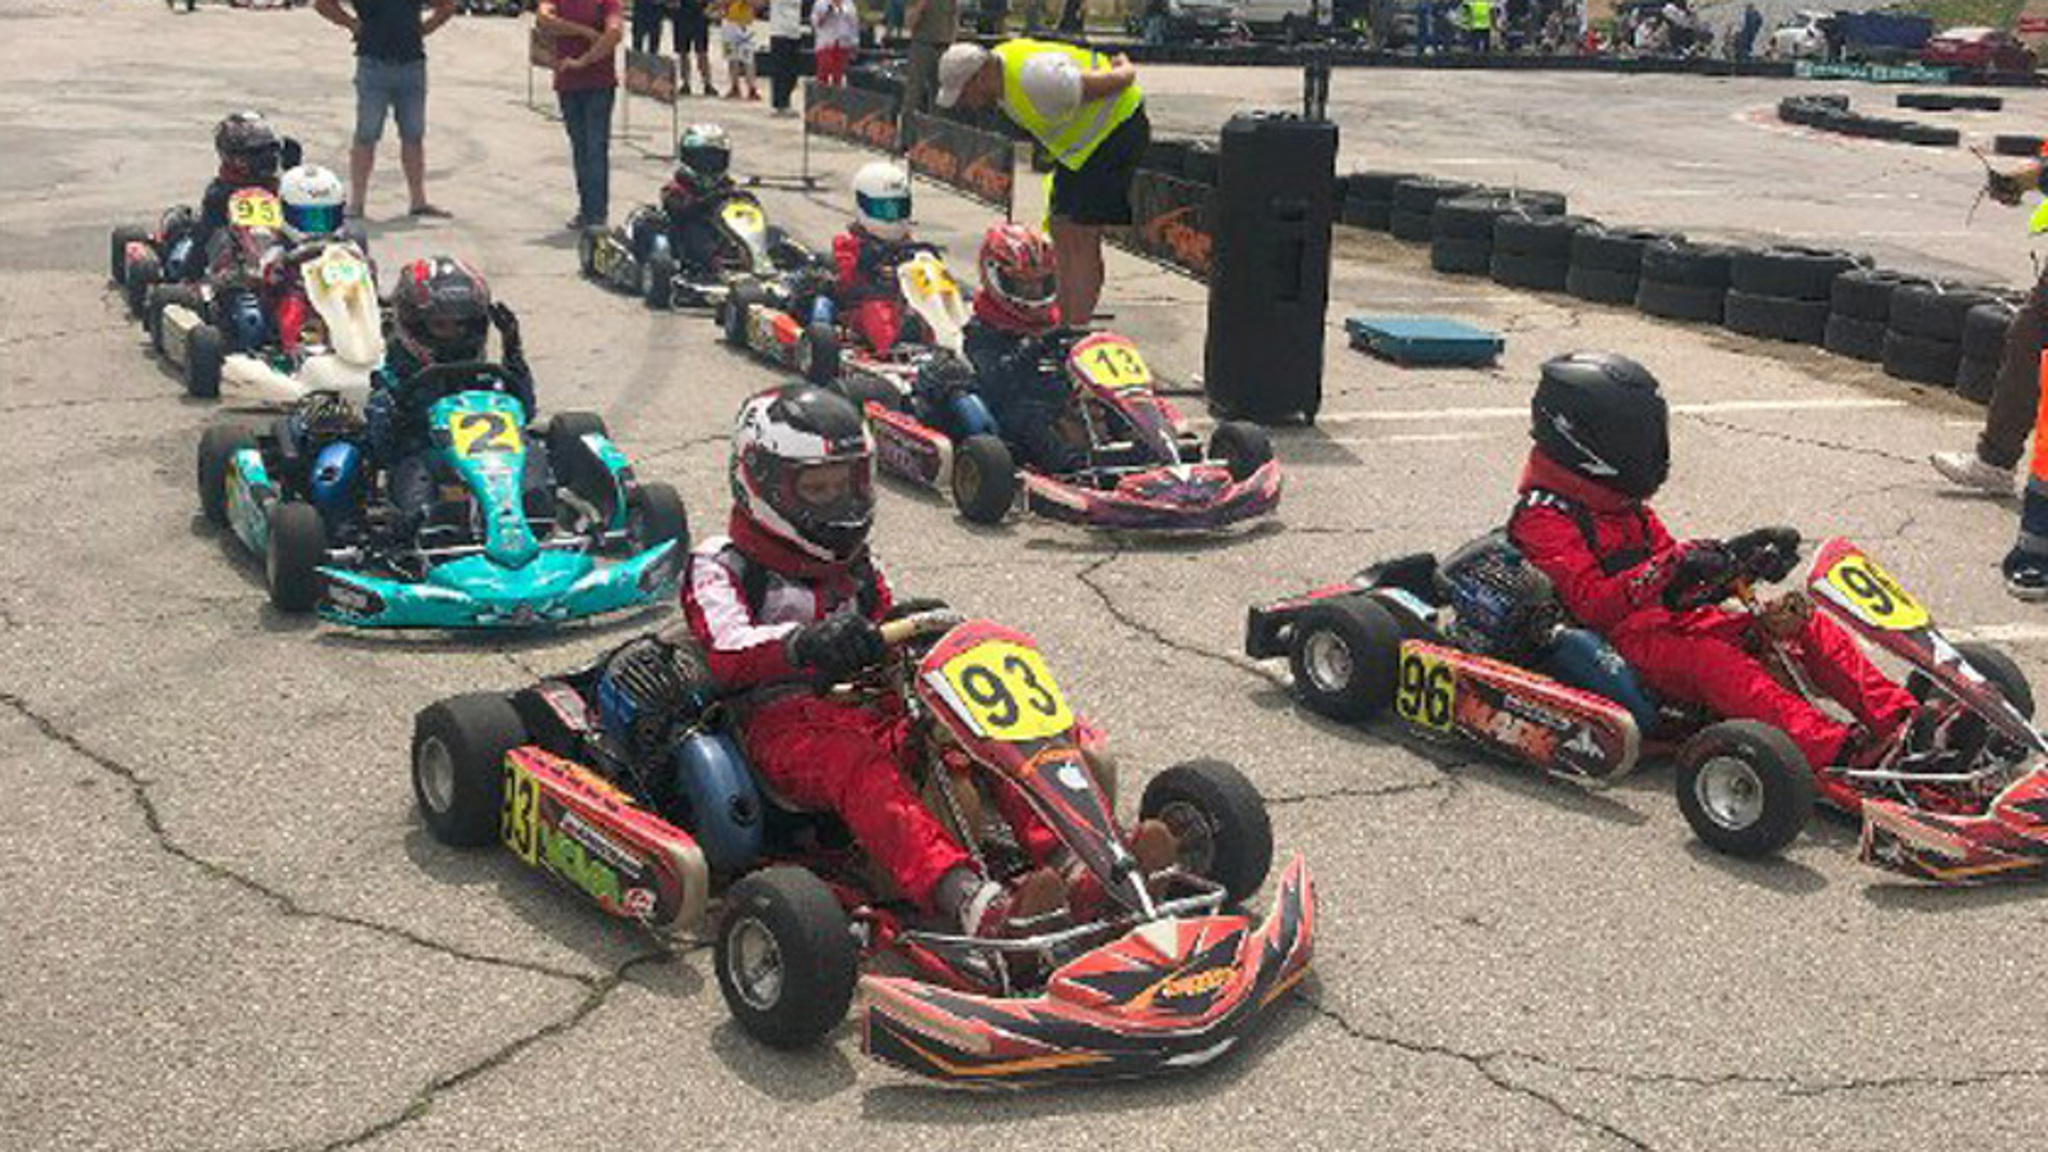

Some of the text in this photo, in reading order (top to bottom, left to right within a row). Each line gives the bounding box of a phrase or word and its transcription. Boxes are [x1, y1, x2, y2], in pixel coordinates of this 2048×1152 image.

[1095, 348, 1142, 378] 13
[459, 412, 517, 456] 2
[960, 654, 1056, 728] 93
[1397, 654, 1451, 726] 96
